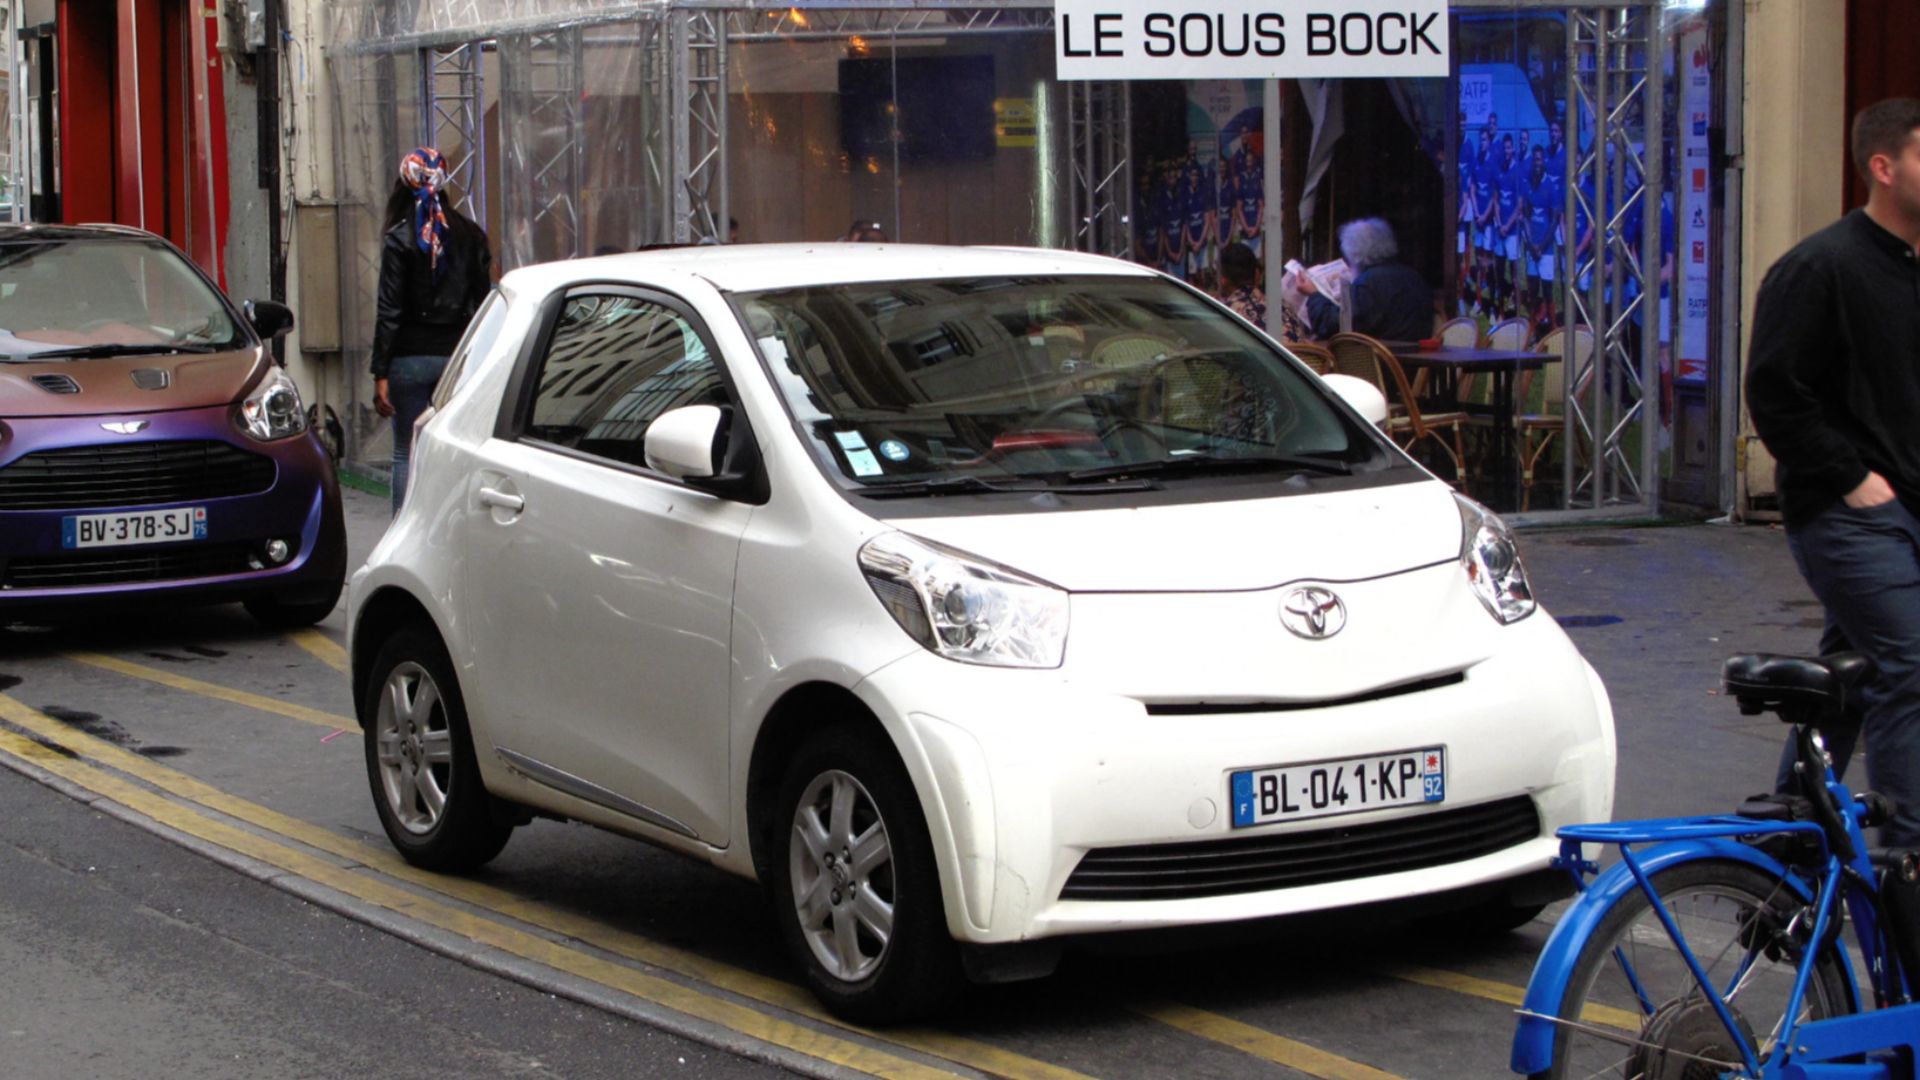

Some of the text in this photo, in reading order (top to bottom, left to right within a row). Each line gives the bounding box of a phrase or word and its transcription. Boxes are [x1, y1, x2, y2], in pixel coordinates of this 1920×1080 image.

[1062, 11, 1442, 58] LE SOUS BOCK
[194, 523, 207, 535] 75
[1424, 776, 1443, 797] 92
[1240, 803, 1248, 816] F
